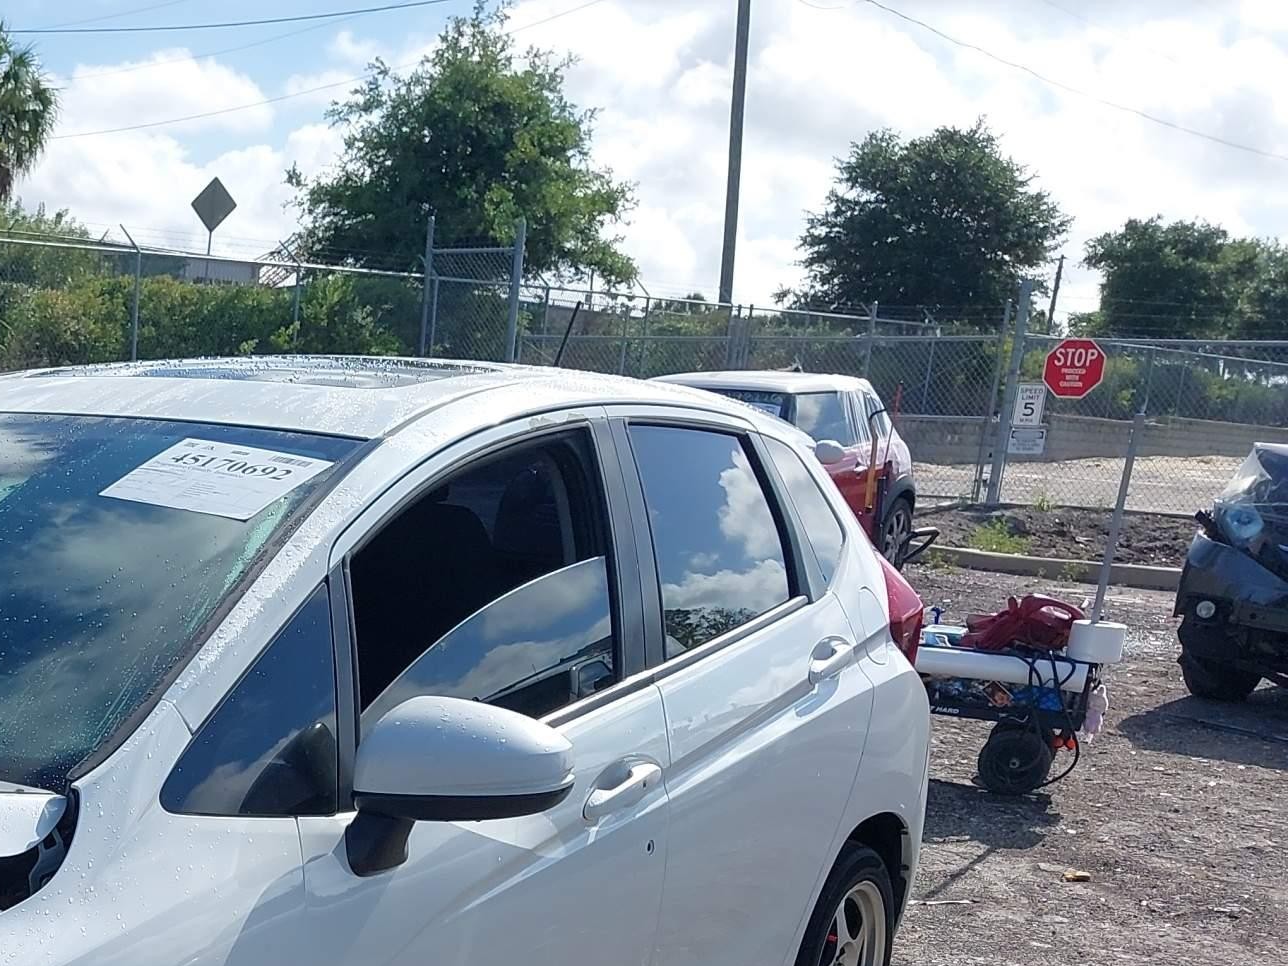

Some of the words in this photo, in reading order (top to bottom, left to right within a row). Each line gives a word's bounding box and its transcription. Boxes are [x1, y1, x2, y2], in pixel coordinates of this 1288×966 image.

[1054, 348, 1098, 367] STOP
[1022, 402, 1035, 417] 5
[171, 452, 293, 481] 45170692
